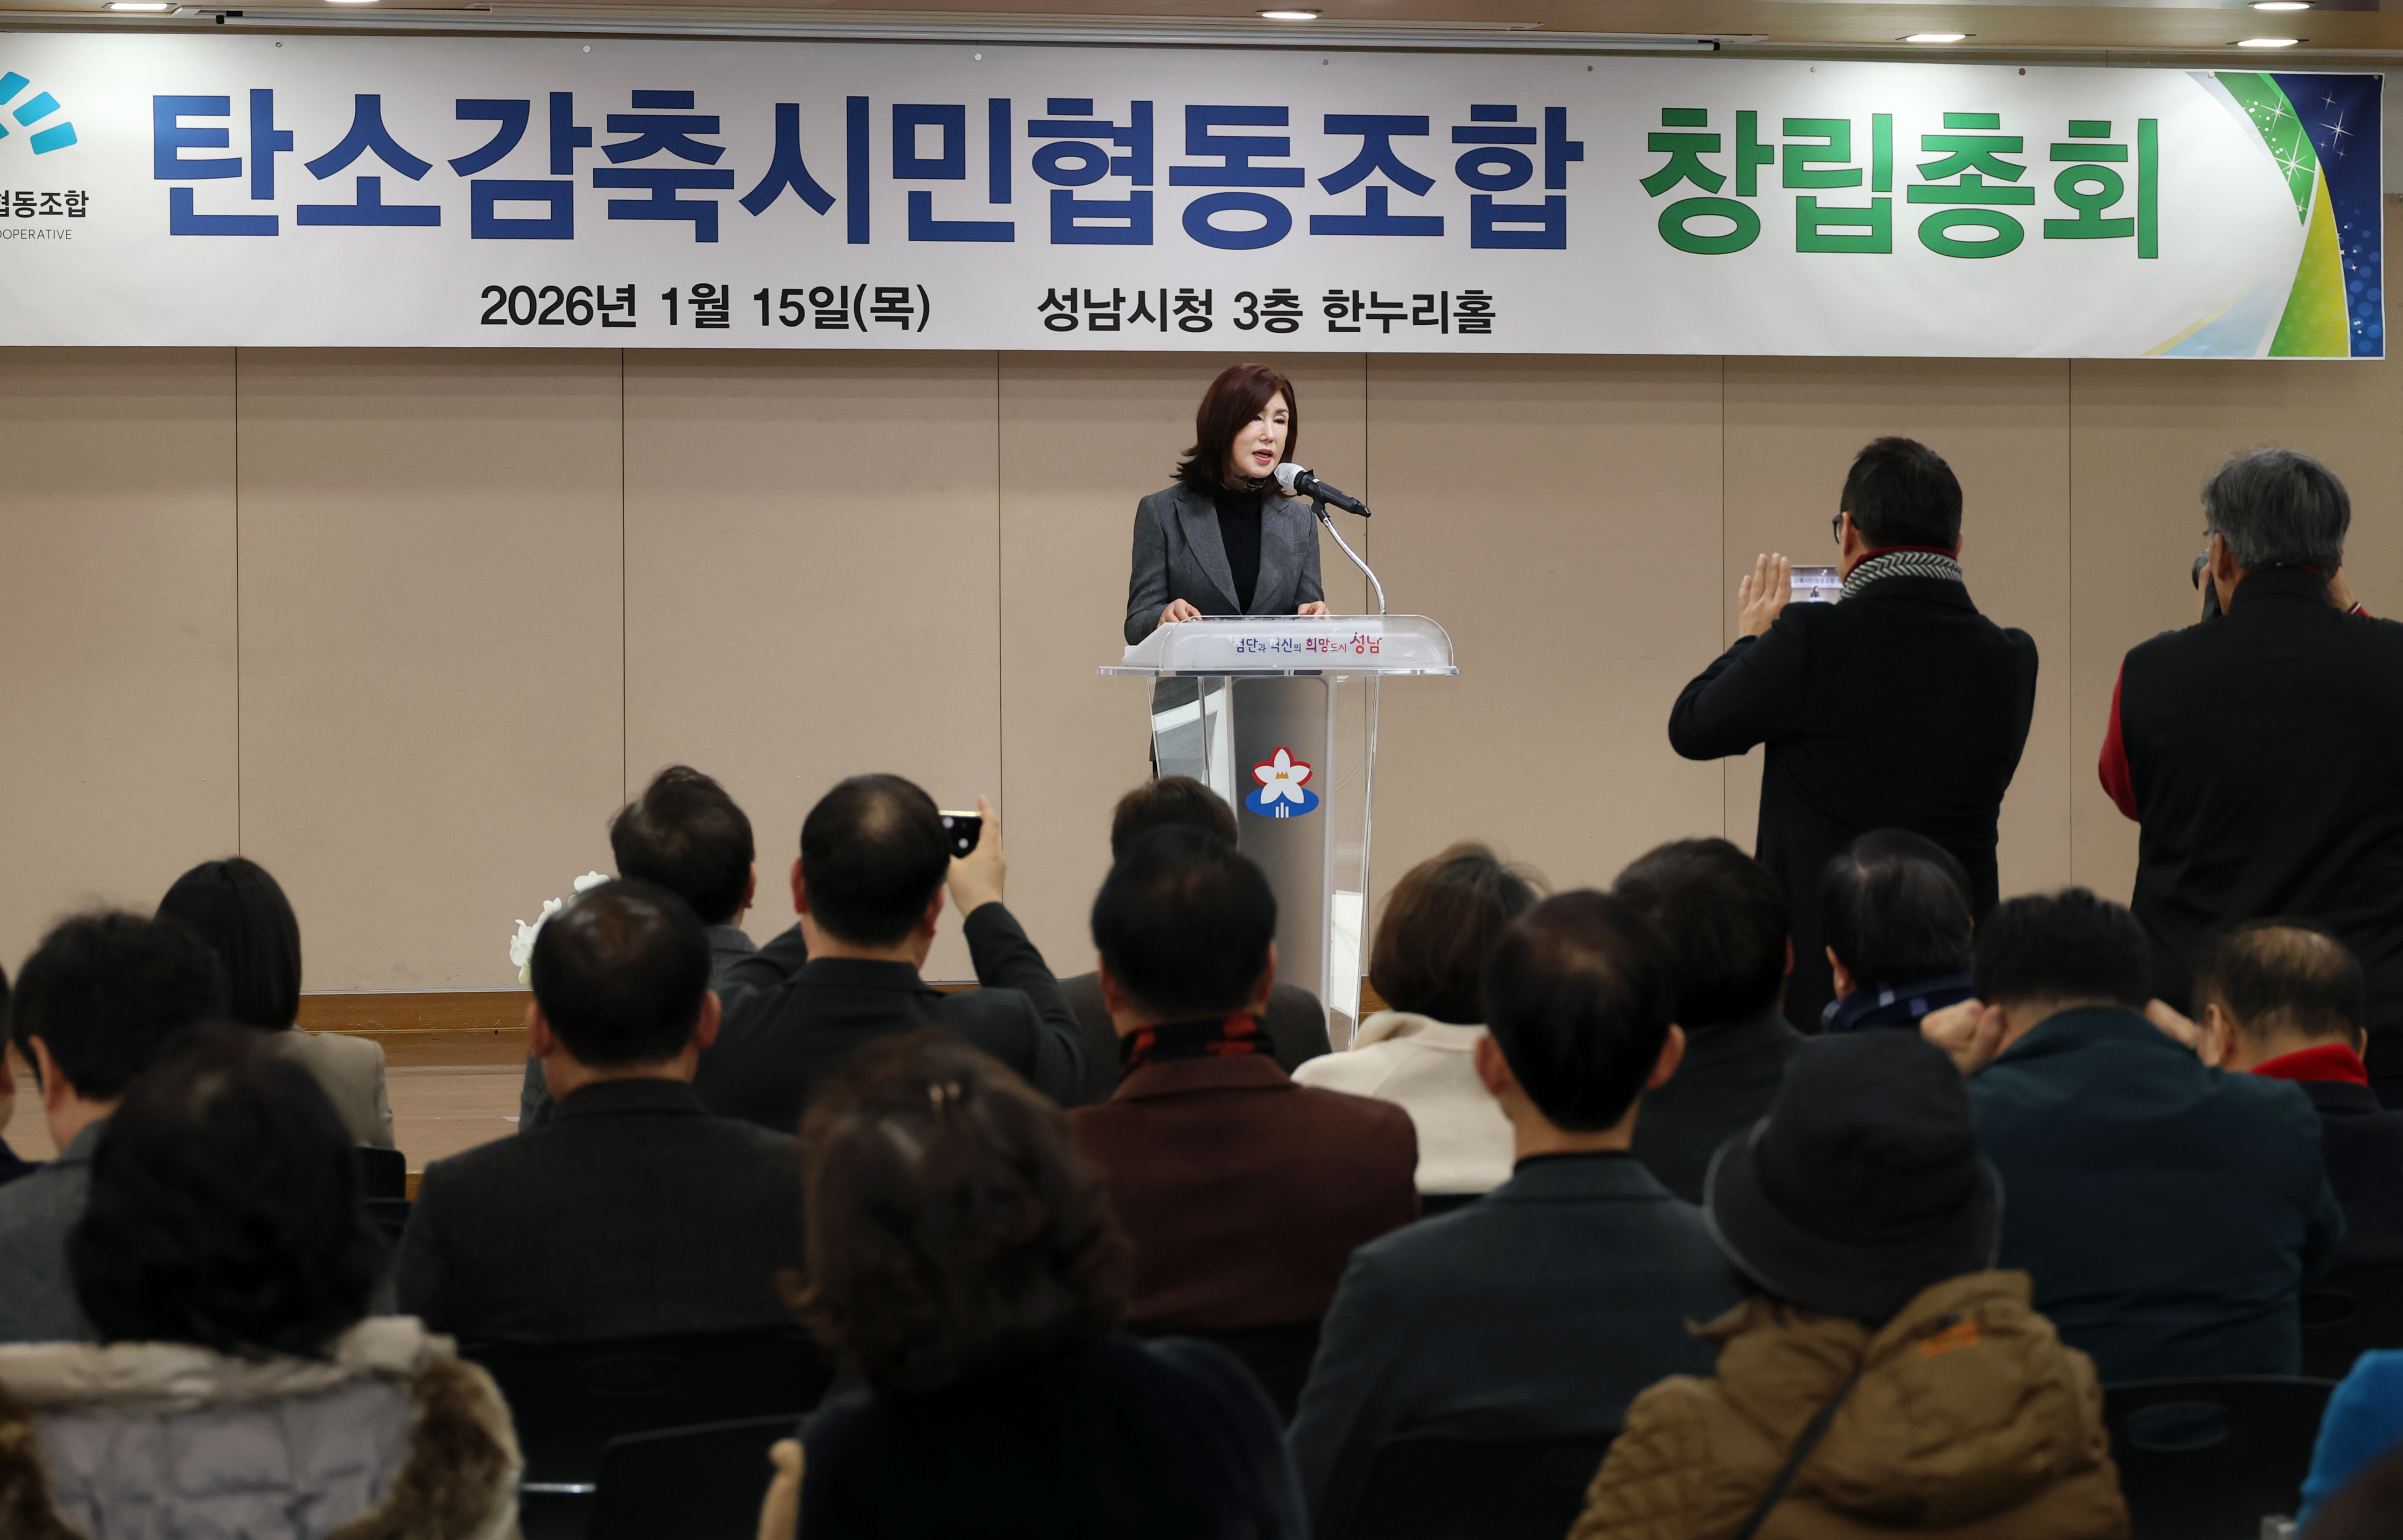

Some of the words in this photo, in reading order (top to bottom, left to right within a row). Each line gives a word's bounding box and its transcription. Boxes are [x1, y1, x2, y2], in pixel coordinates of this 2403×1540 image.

[153, 88, 1584, 250] 탄소감축시민협동조합
[1639, 107, 2158, 259] 창립총회
[0, 229, 72, 239] OPERATIVE
[481, 284, 636, 328] 2026년
[662, 283, 730, 329] 1월
[754, 283, 930, 332] 15일(목)
[1037, 287, 1213, 333] 성남시청
[1233, 288, 1303, 334] 3층
[1322, 289, 1496, 334] 한누리홀
[1306, 637, 1347, 653] 희망도시
[1350, 632, 1383, 654] 성남
